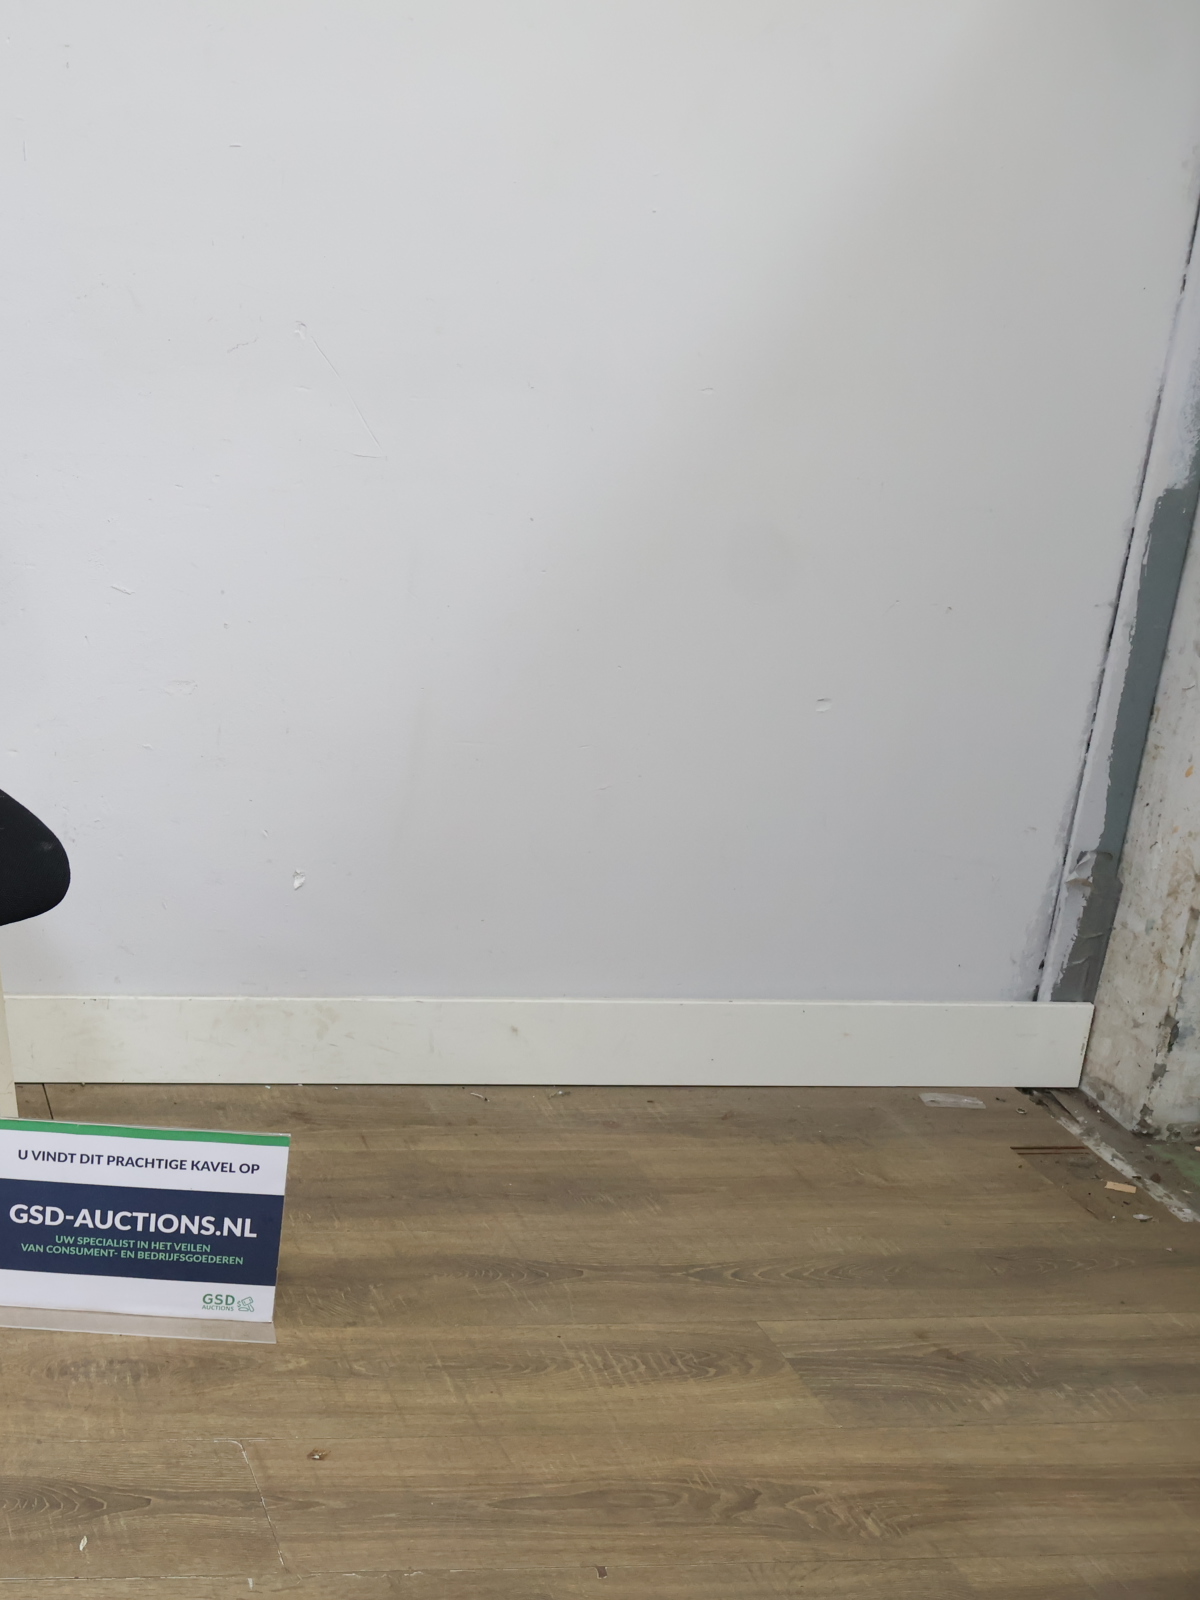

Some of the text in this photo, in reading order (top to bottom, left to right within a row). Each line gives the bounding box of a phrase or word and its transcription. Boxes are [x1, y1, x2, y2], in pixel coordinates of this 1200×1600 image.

[18, 1149, 260, 1174] U VINDT DIT PRACHTIGE KAVEL OP
[9, 1204, 257, 1238] GSD-AUCTIONS.NL
[21, 1243, 243, 1265] VAN CONSUMENT- EN BEDRIJFSGOEDEREN
[55, 1235, 211, 1253] UW SPECIALIST IN HET VEILEN
[202, 1294, 235, 1306] GSD
